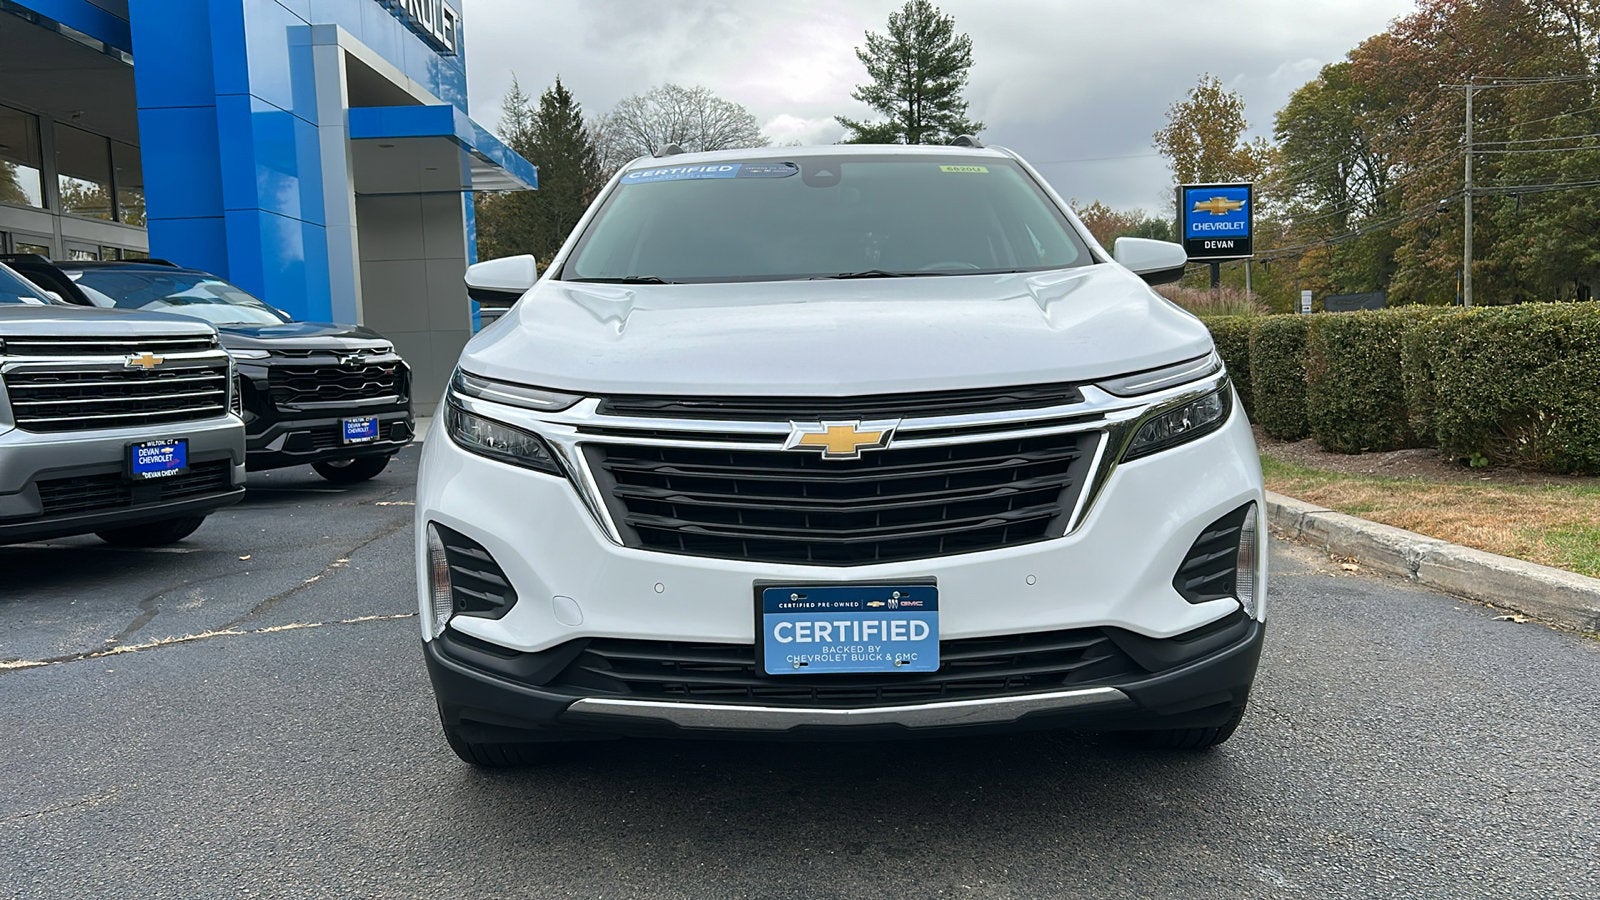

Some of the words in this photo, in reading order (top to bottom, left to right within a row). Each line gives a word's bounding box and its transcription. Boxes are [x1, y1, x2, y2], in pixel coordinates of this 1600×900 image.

[629, 165, 733, 179] CERTIFIED
[1192, 222, 1245, 231] CHEVROLET
[1204, 240, 1234, 248] DEVAN
[138, 448, 160, 456] DEVAN
[138, 454, 173, 464] CHEVROLET
[773, 619, 930, 643] CERTIFIED
[822, 645, 865, 654] BACKED
[868, 645, 881, 653] BY
[786, 653, 847, 663] CHEVROLET
[851, 653, 884, 661] BUICK
[895, 652, 918, 661] GMC
